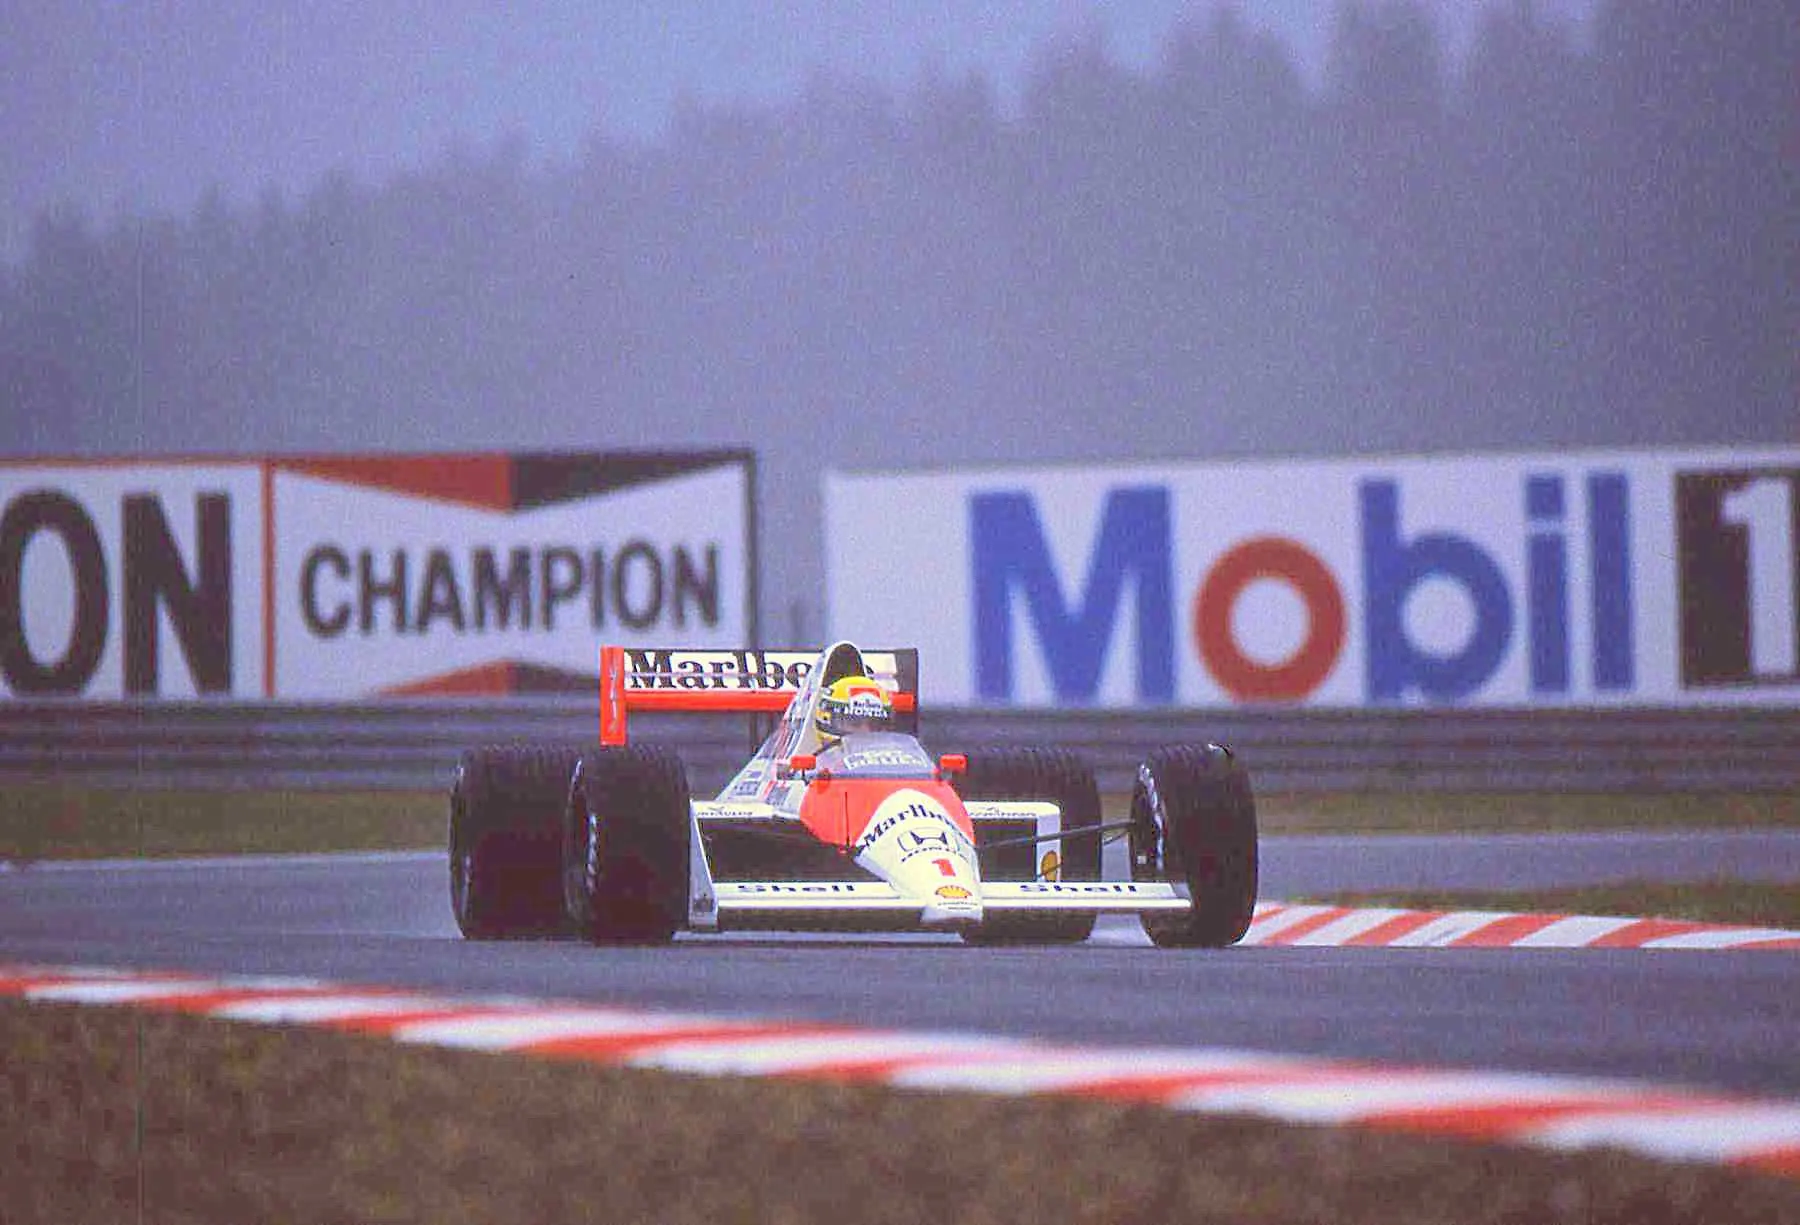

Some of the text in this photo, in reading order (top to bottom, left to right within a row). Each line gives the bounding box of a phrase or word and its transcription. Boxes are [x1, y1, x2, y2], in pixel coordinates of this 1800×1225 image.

[0, 488, 233, 697] ON
[302, 540, 719, 638] CHAMPION
[967, 472, 1794, 704] Mobil 1
[625, 650, 872, 691] Marlbo
[931, 858, 956, 877] 1
[737, 884, 855, 893] Shell
[1019, 884, 1137, 893] Shell
